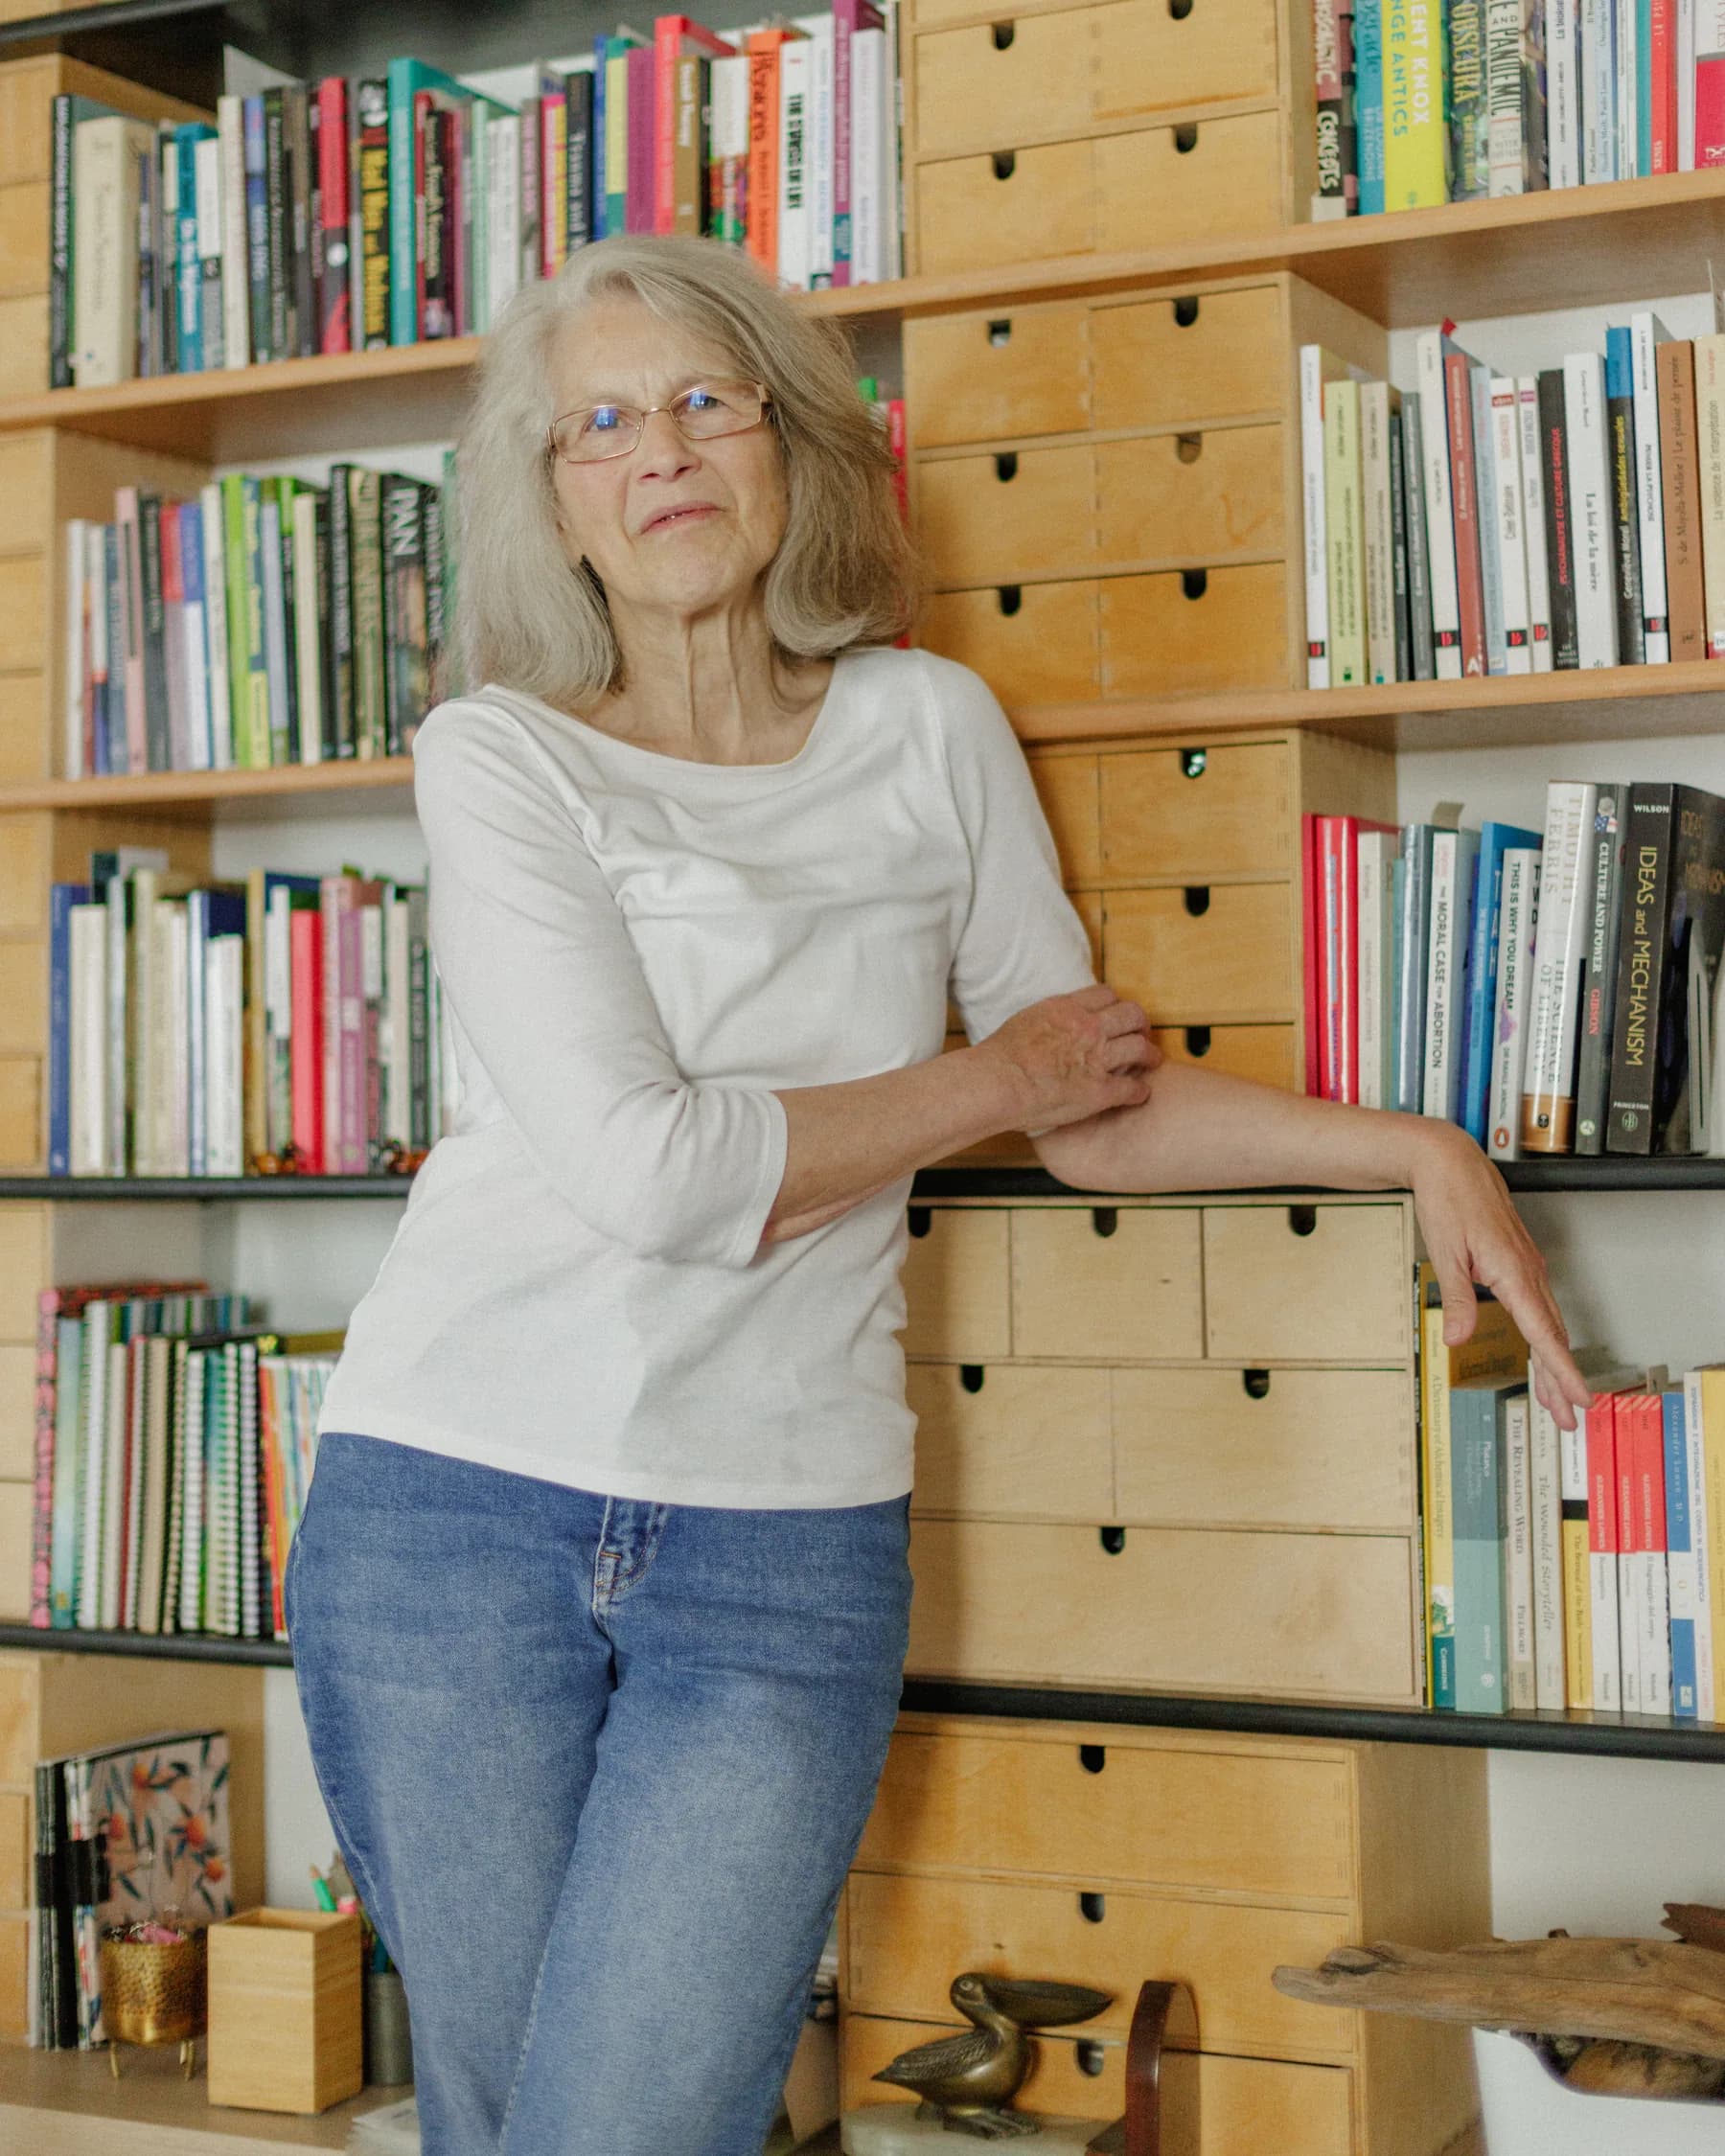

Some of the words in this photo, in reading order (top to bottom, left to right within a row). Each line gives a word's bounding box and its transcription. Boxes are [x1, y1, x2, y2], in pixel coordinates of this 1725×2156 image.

[1452, 3, 1483, 103] OBSCURA
[1488, 27, 1522, 116] PANDEMIC
[1392, 53, 1409, 138] ANTICS
[1410, 57, 1431, 126] KNOX
[389, 487, 420, 557] PAN
[1633, 804, 1669, 814] WILSON
[1510, 860, 1522, 889] THIS
[1596, 841, 1611, 901] CULTURE
[1636, 845, 1657, 906] IDEAS
[1507, 906, 1520, 934] WHY
[1509, 892, 1520, 904] IS
[1594, 902, 1607, 927] AND
[1437, 901, 1448, 946] MORAL
[1635, 909, 1651, 935] and
[1436, 950, 1446, 982] CASE
[1506, 938, 1517, 962] YOU
[1592, 928, 1605, 973] POWER
[1588, 988, 1602, 1035] GIBSON
[1624, 941, 1652, 1067] MECHANISM
[1432, 1001, 1445, 1069] ABORTION
[1512, 1416, 1524, 1441] THE
[1513, 1444, 1526, 1512] REVEALING
[1538, 1475, 1551, 1498] The
[1514, 1515, 1527, 1554] WORD
[1539, 1502, 1552, 1561] Wounded
[1539, 1564, 1555, 1631] Storyteller
